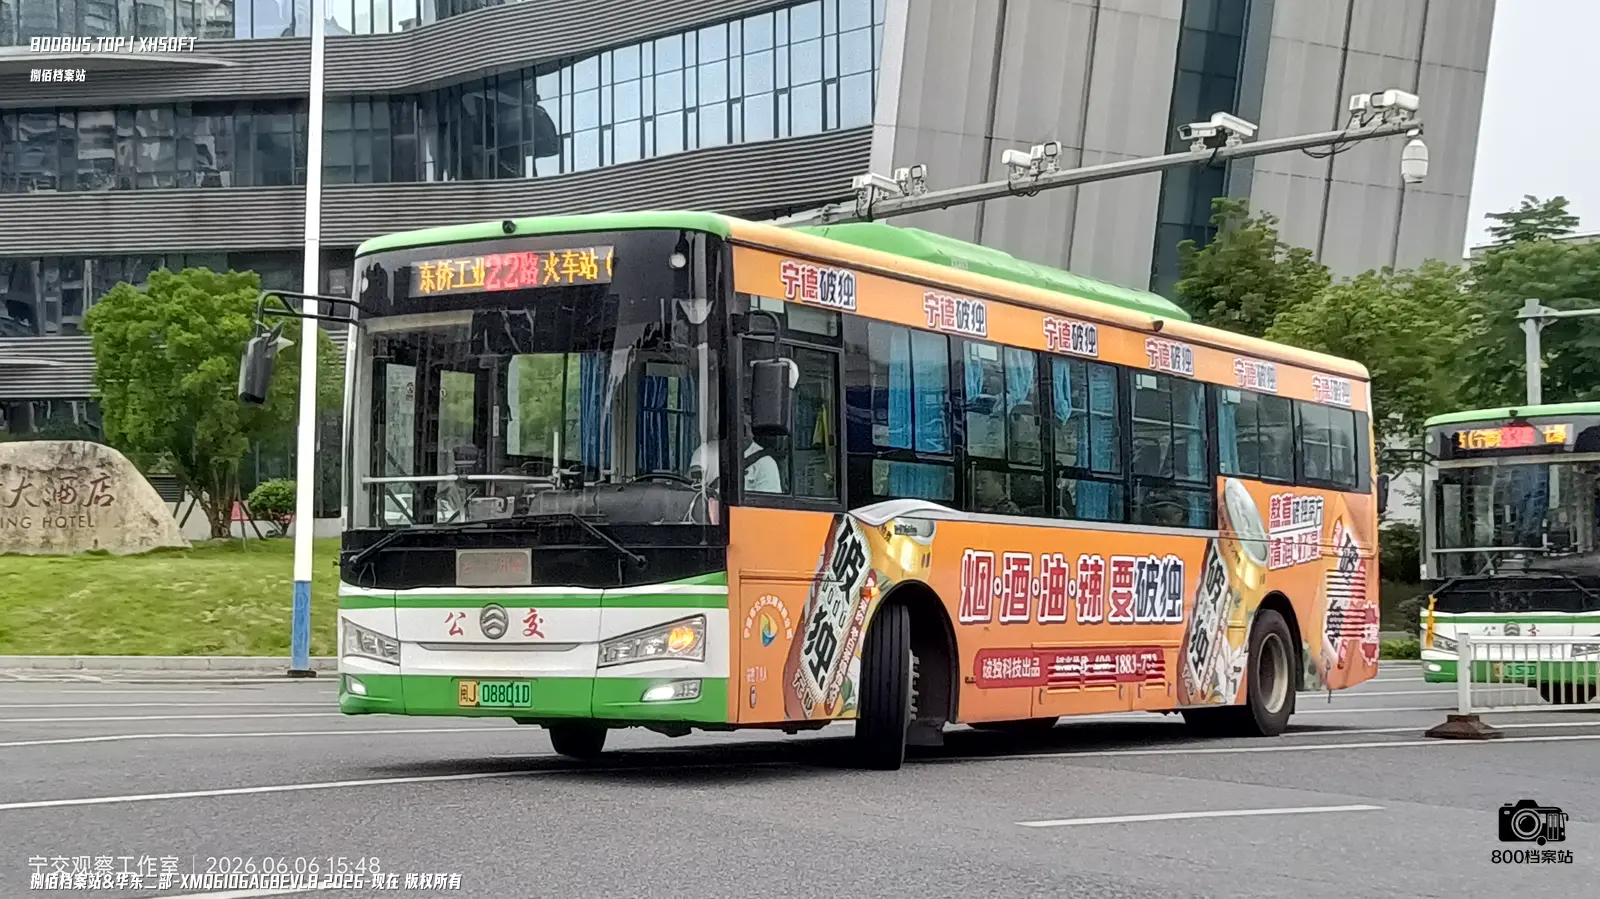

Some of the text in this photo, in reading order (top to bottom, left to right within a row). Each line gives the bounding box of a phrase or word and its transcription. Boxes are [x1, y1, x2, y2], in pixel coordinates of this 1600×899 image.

[485, 252, 540, 291] 22路
[781, 261, 855, 310] 宁德破独
[923, 292, 987, 337] 宁德破独
[1043, 316, 1098, 359] 宁德破独
[1146, 338, 1194, 376] 宁德破独
[0, 472, 115, 509] 大酒店
[42, 514, 95, 529] HOTEL
[445, 608, 545, 639] 公 交
